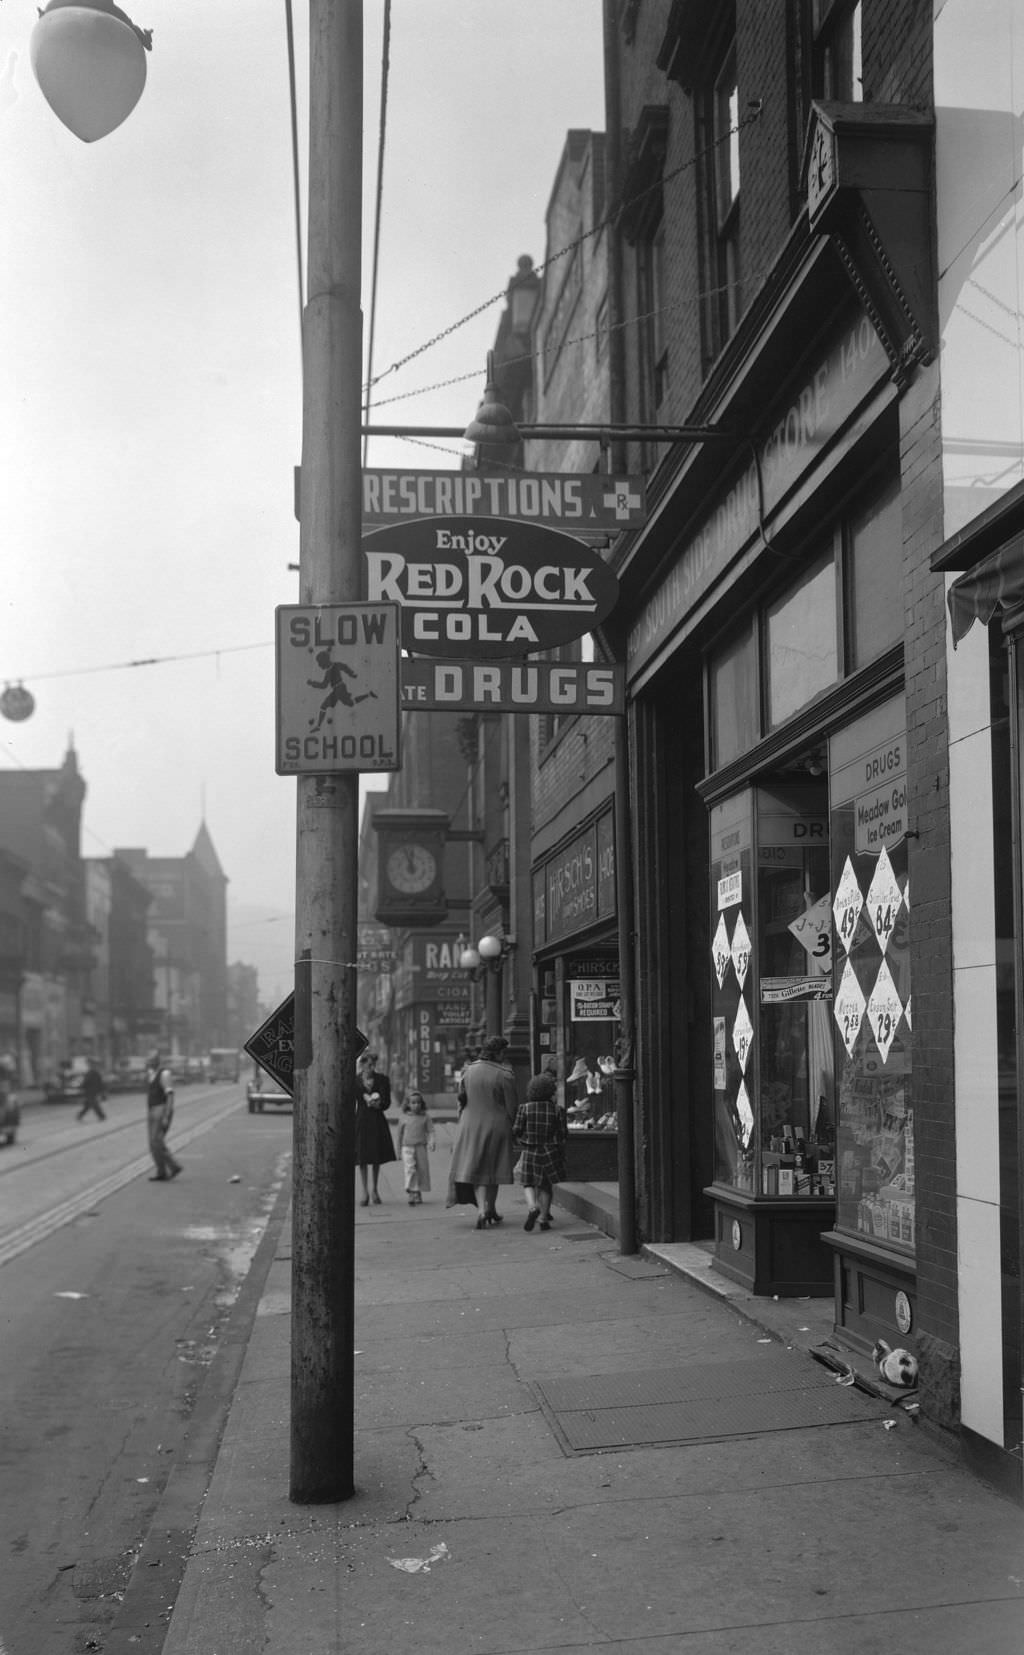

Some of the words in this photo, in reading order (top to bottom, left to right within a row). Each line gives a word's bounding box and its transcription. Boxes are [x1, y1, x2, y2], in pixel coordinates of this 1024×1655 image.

[363, 474, 582, 518] RESCRIPTIONS
[436, 529, 508, 555] Enjoy
[289, 613, 388, 647] SLOW
[413, 612, 539, 643] COLA
[434, 665, 614, 706] DRUGS
[285, 734, 393, 760] SCHOOL
[866, 746, 900, 782] DRUGS
[858, 798, 890, 826] Meadow
[892, 784, 908, 811] Gol
[793, 822, 829, 838] DR
[867, 828, 878, 844] Ice
[879, 819, 902, 840] Cream
[812, 933, 830, 957] 3
[420, 1010, 431, 1083] DRUGS
